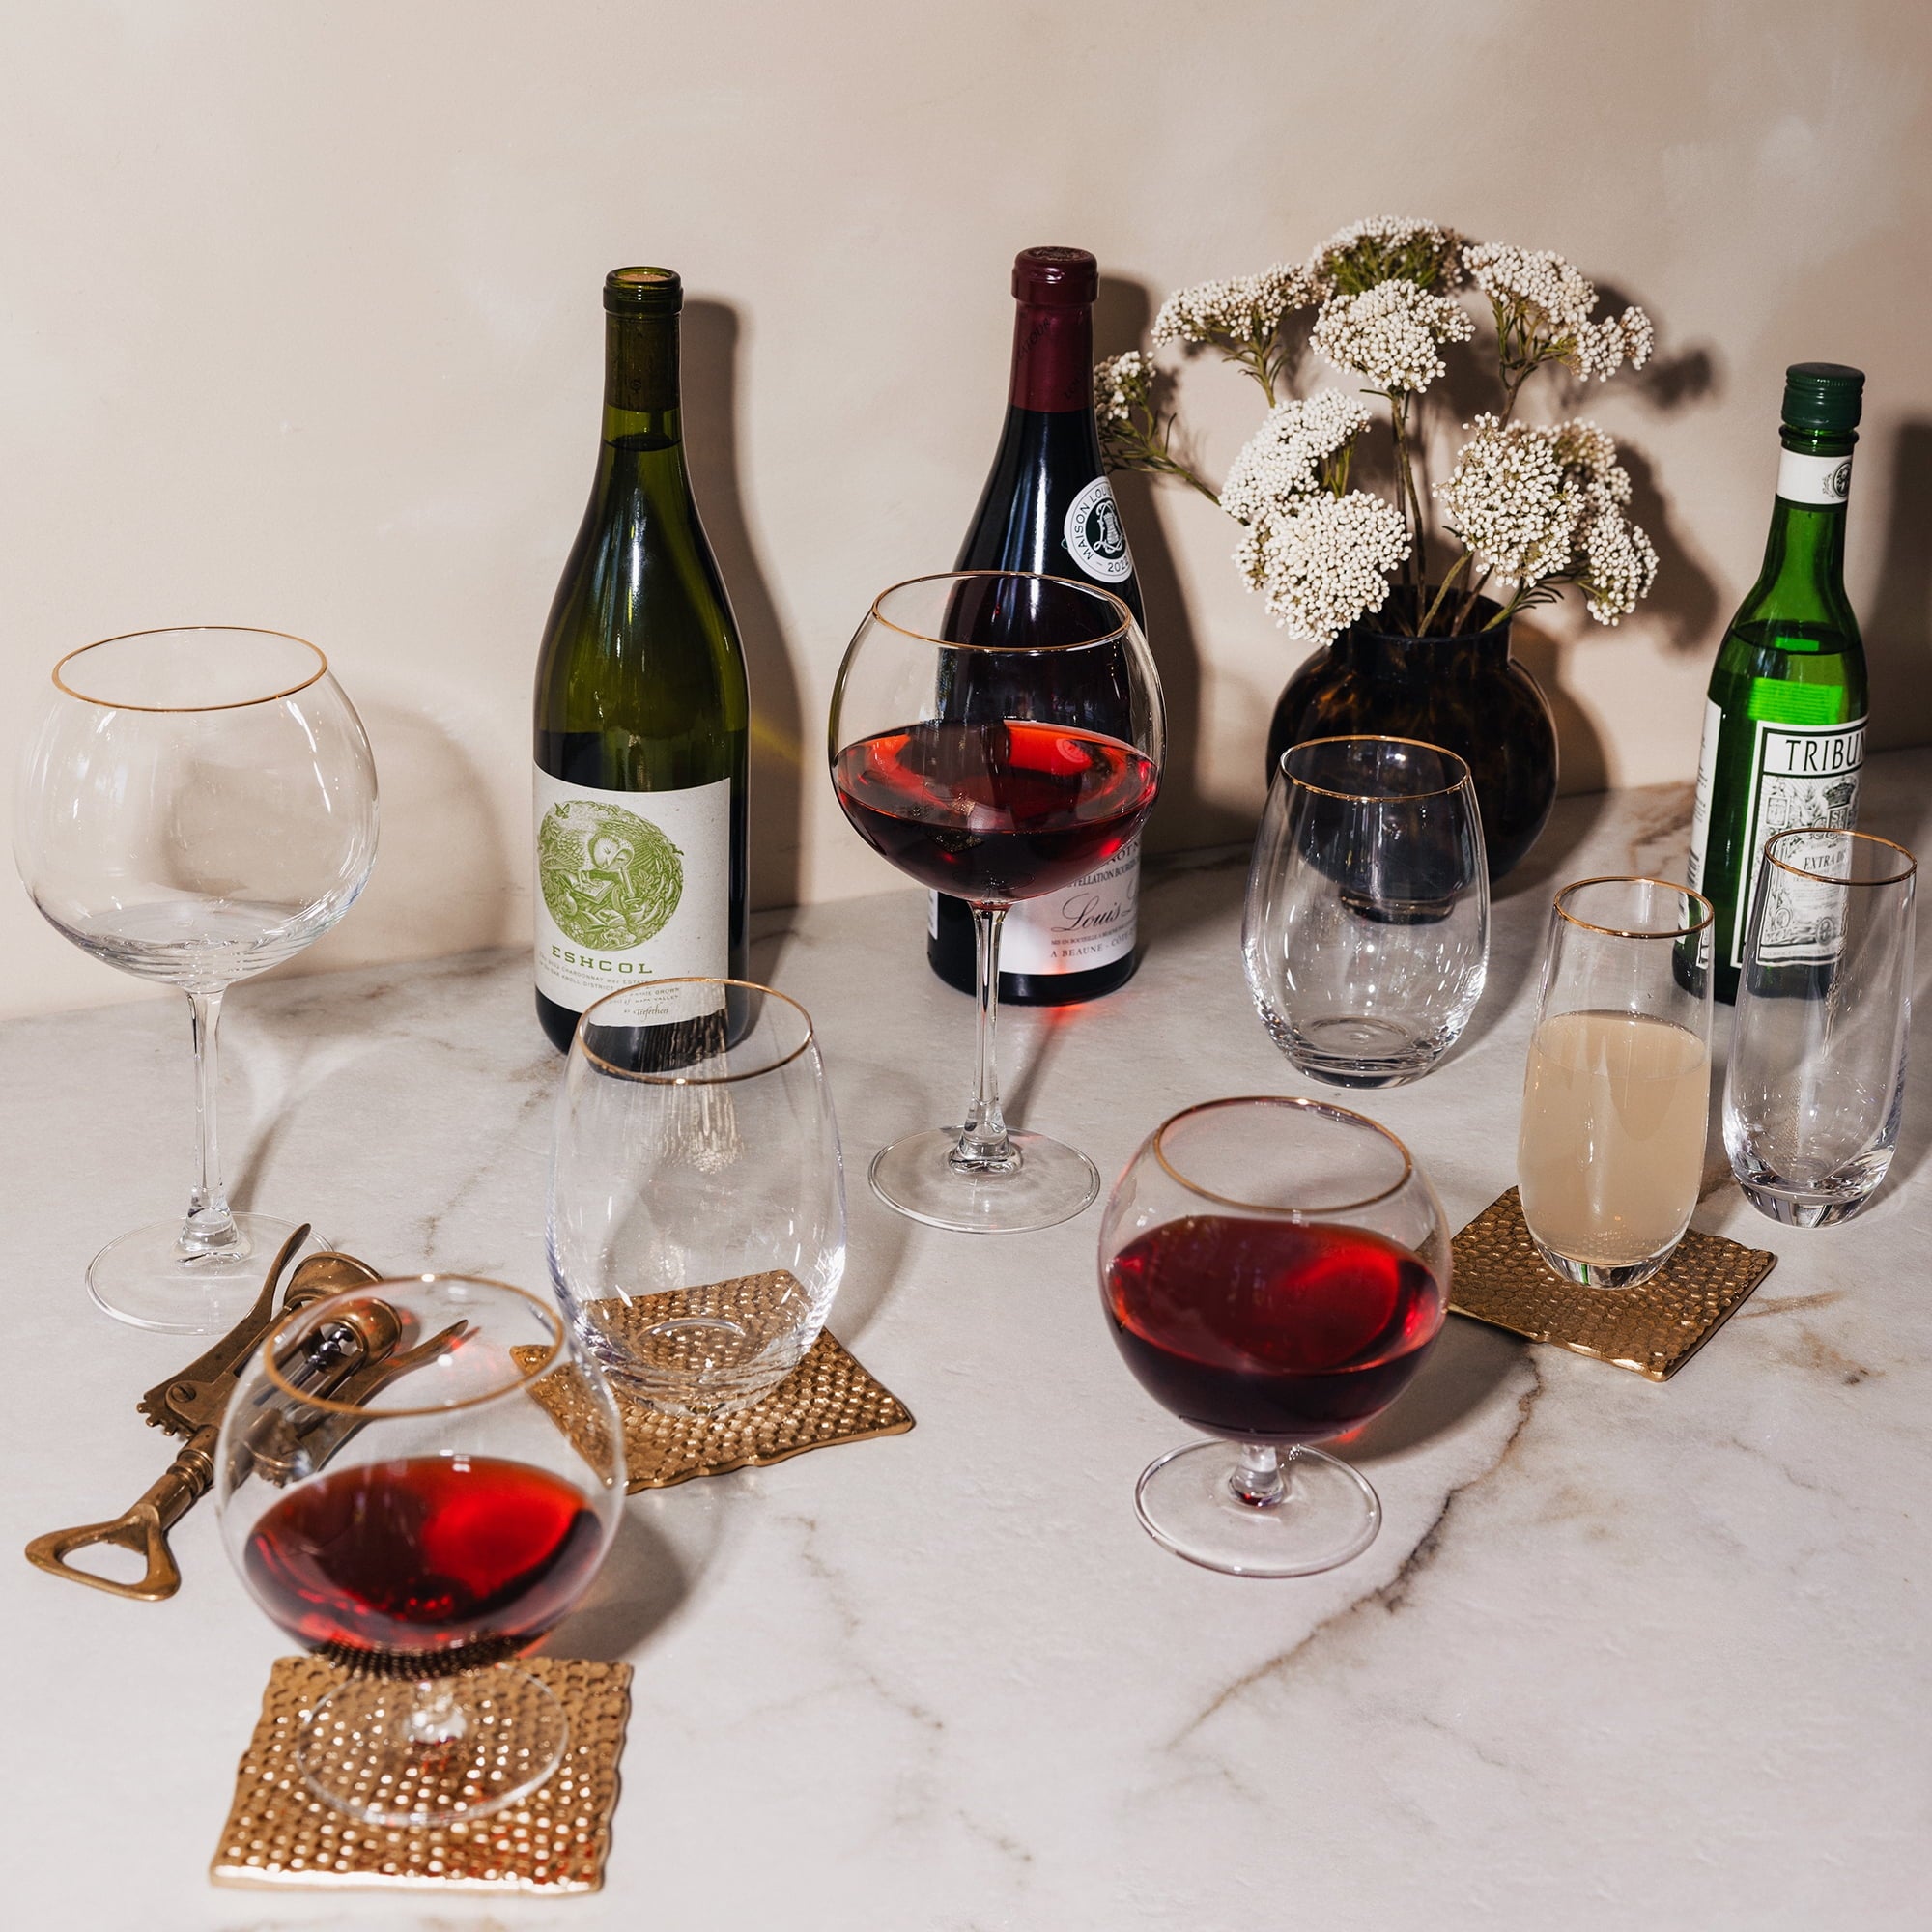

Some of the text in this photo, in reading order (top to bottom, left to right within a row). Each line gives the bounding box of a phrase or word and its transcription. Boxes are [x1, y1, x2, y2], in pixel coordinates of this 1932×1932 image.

[1074, 502, 1094, 560] MAISON
[1804, 854, 1834, 870] EXTRA
[1050, 892, 1122, 933] Louis
[552, 945, 653, 974] ESHCOL
[1062, 943, 1103, 958] BEAUNE
